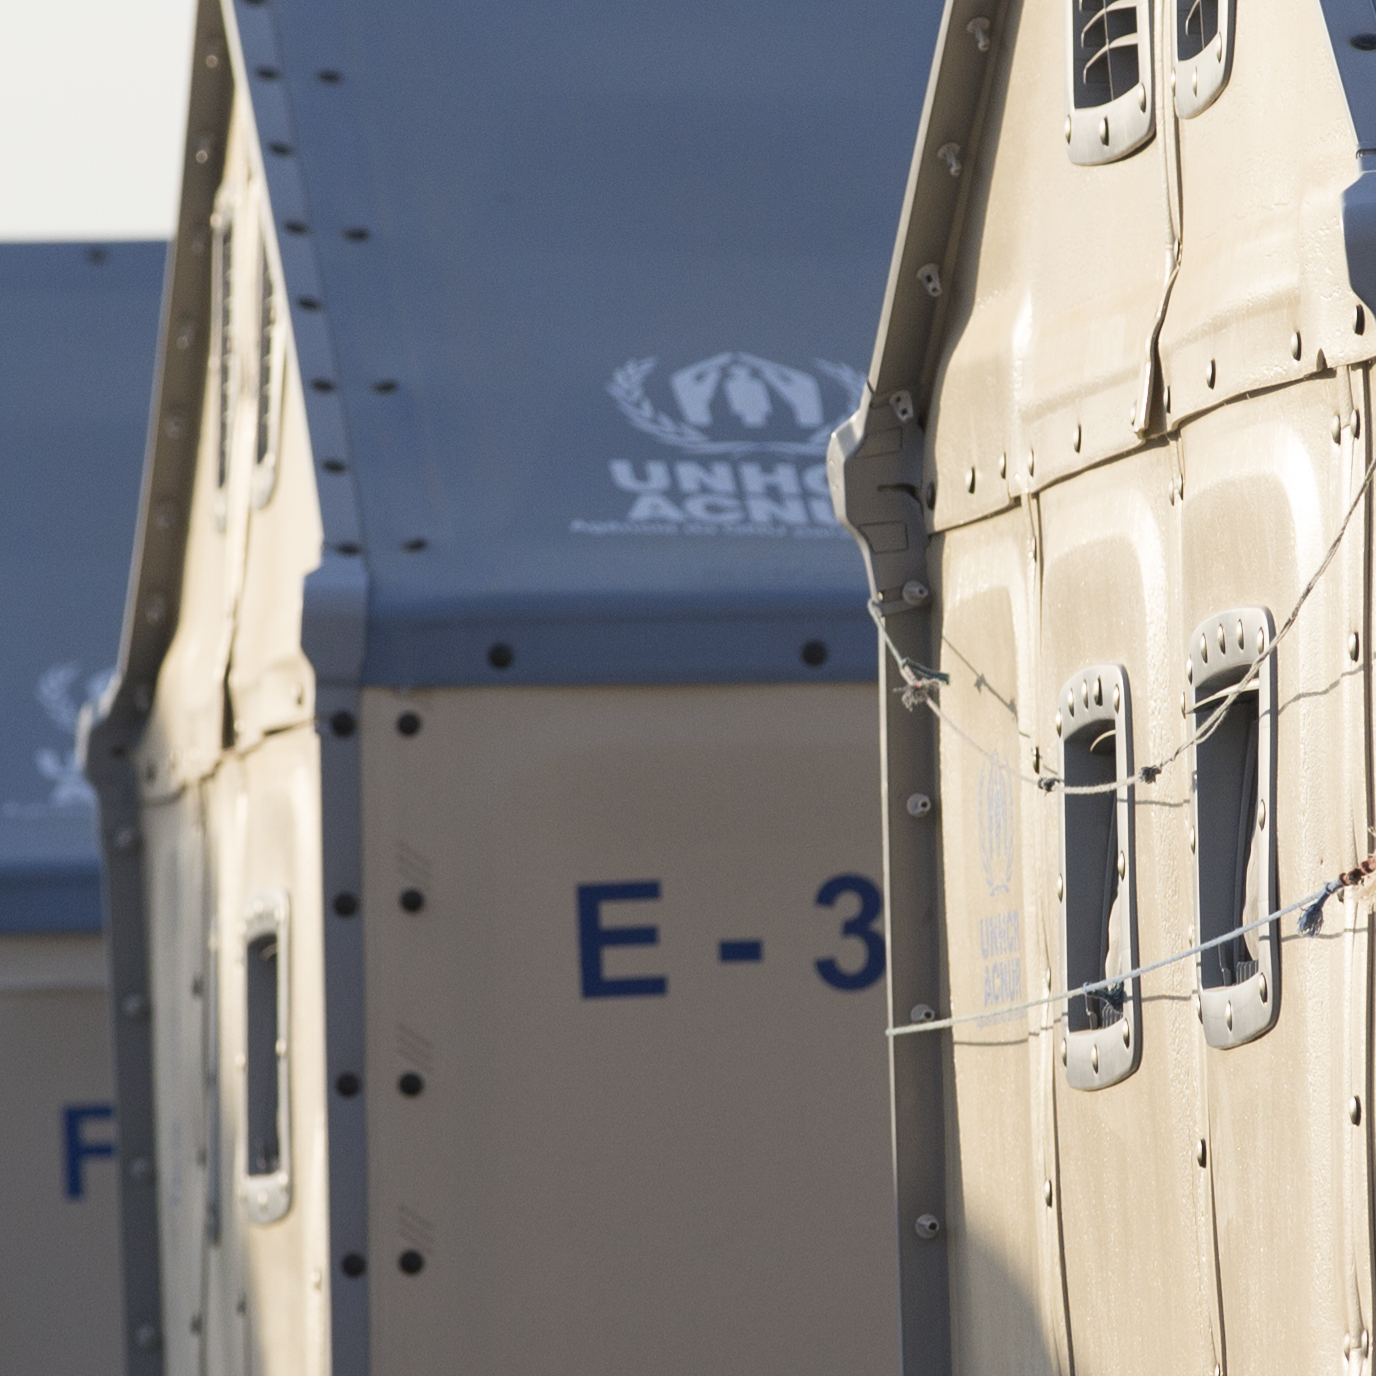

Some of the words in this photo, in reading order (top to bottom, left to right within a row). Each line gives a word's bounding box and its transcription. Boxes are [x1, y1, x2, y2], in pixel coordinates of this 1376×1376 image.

[577, 877, 669, 1000] E
[718, 937, 763, 964] -
[813, 869, 887, 995] 3
